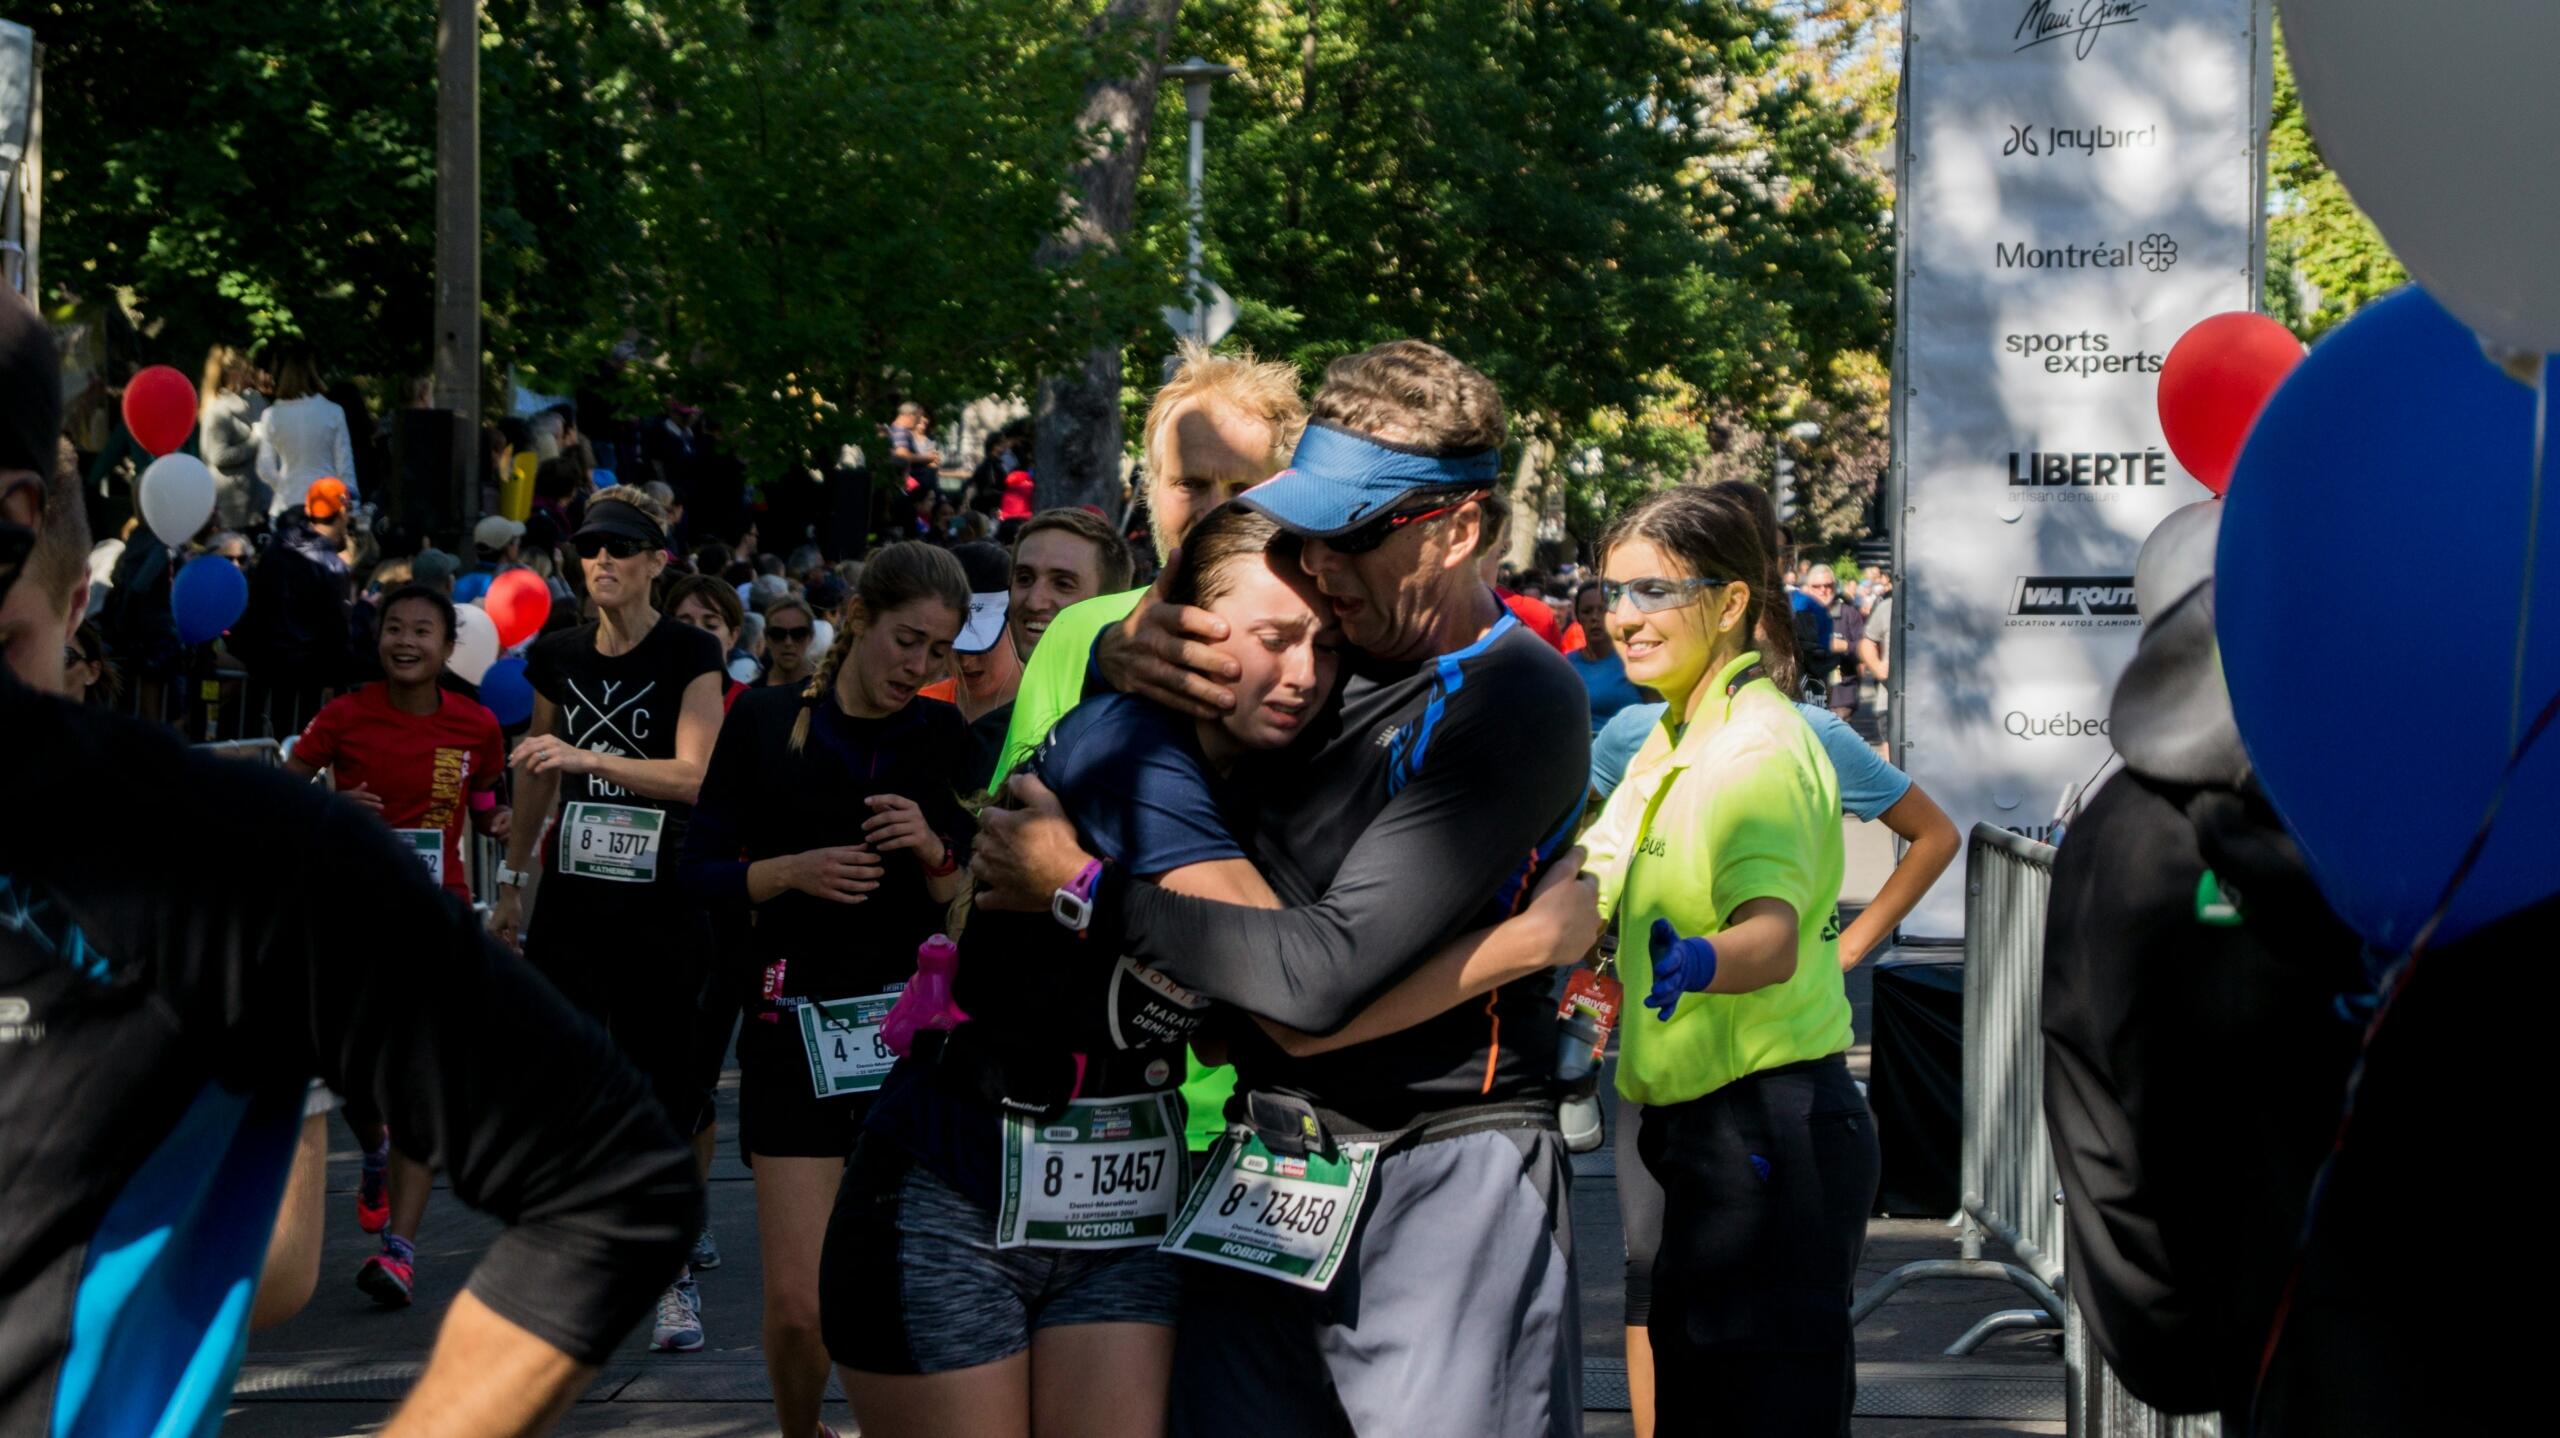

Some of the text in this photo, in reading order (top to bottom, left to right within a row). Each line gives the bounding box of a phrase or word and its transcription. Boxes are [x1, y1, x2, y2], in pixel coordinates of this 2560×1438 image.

[2014, 0, 2074, 40] Maui
[1997, 240, 2133, 268] Montréal
[2006, 329, 2109, 357] sports
[2044, 351, 2162, 378] experts
[2008, 446, 2166, 486] LIBERTÉ
[2008, 489, 2054, 502] artisan
[2024, 586, 2138, 615] VIA ROUT
[2059, 619, 2094, 627] AUTOS
[2097, 619, 2143, 627] CAMIONS
[2003, 711, 2110, 740] Québec
[581, 828, 593, 850] 8
[609, 831, 650, 856] 13717
[1569, 992, 1613, 1013] ARRIVÉE
[834, 1037, 848, 1062] 4
[1043, 1156, 1064, 1197] 8
[1091, 1148, 1167, 1196] 13457
[1219, 1183, 1248, 1216] 8
[1256, 1190, 1336, 1236] 13458
[1066, 1222, 1135, 1238] VICTORIA
[1219, 1242, 1278, 1264] ROBERT
